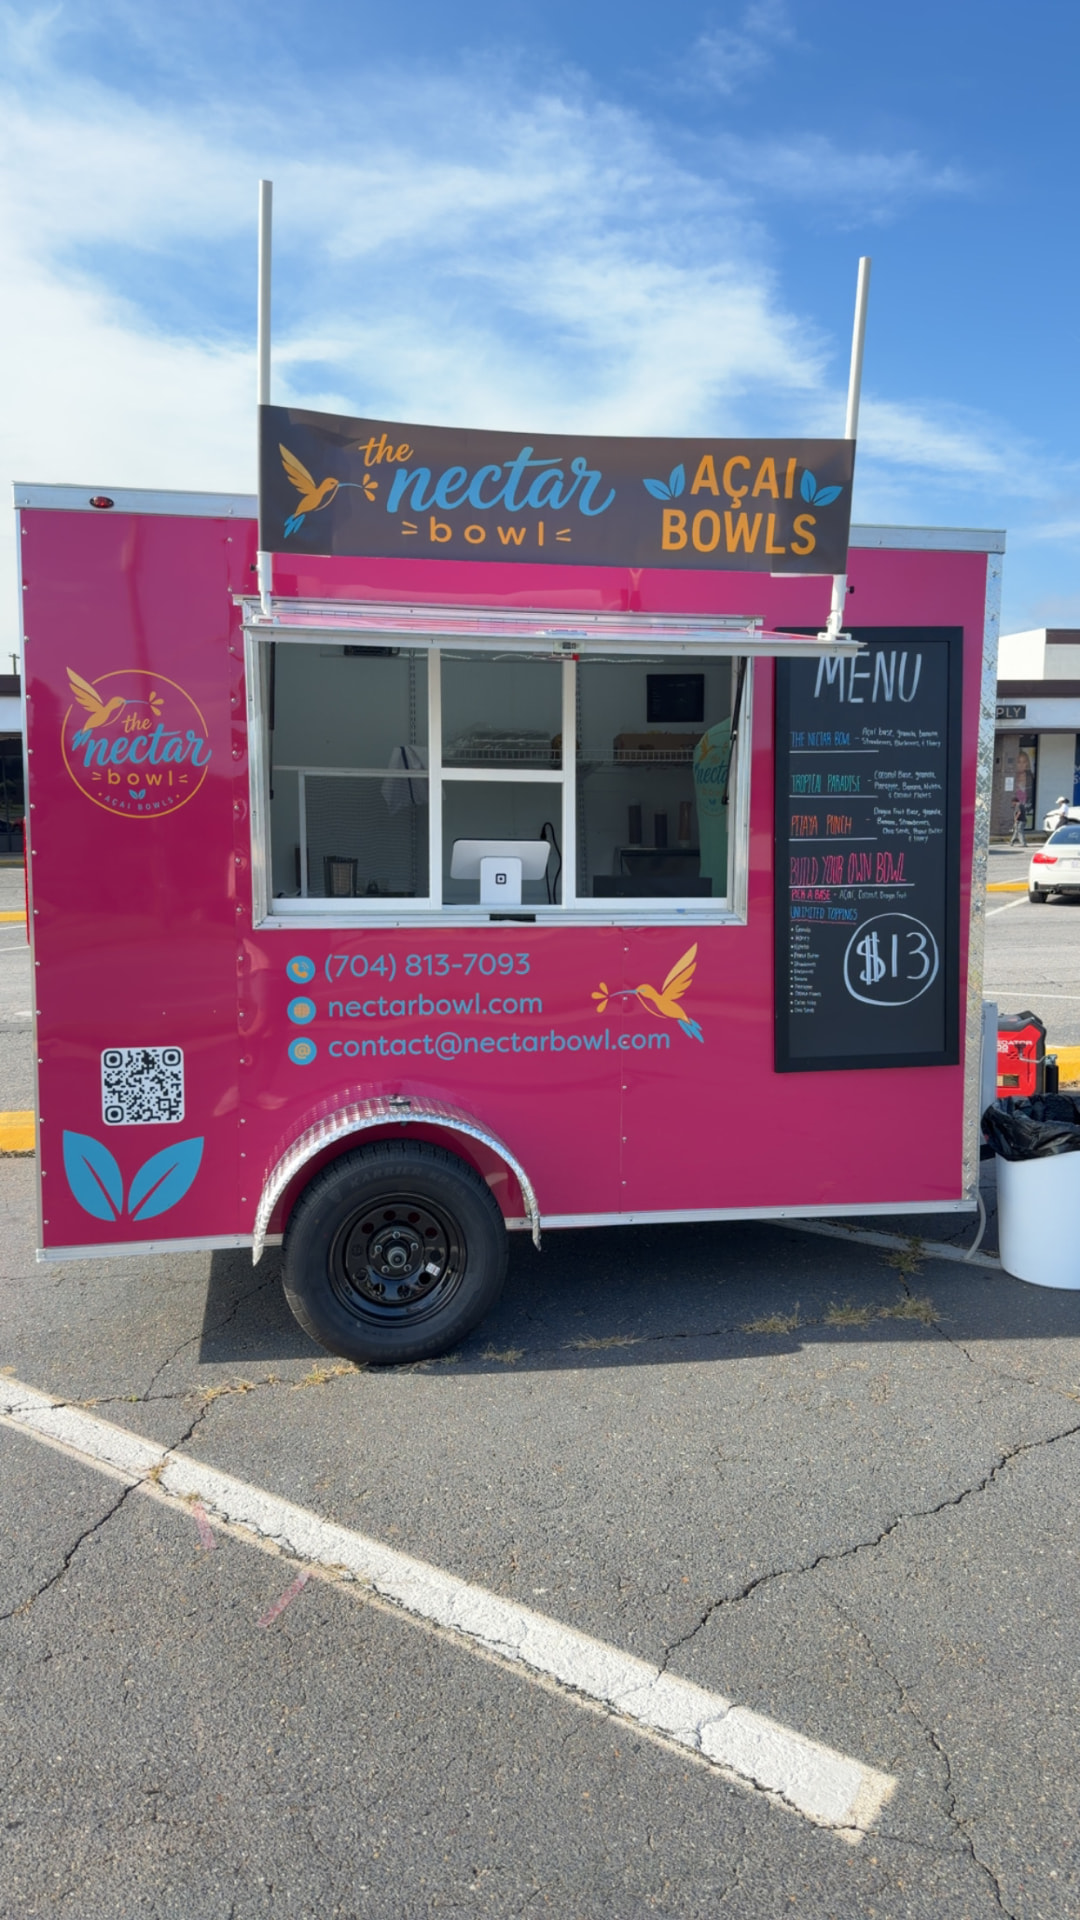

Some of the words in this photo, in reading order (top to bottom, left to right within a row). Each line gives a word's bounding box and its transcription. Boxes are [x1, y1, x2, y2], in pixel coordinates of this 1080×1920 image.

[357, 433, 414, 467] the
[386, 446, 616, 516] nectar
[689, 454, 798, 510] AÇAI
[429, 515, 545, 546] bowl
[661, 508, 818, 556] BOWLS
[813, 650, 923, 703] MENU
[121, 711, 152, 734] the
[84, 723, 212, 767] nectar
[790, 731, 805, 747] THE
[107, 767, 173, 786] bowl
[791, 773, 822, 793] TROPICAL
[827, 774, 861, 793] PARADISE
[137, 796, 174, 811] BOWLS
[790, 814, 819, 837] PITAYA
[825, 813, 853, 837] PUNCH
[789, 856, 819, 886] BUILD
[821, 855, 844, 885] YOUR
[847, 852, 873, 885] OWN
[875, 851, 907, 884] BOWL
[807, 888, 813, 899] A
[814, 888, 830, 900] BASE
[789, 905, 825, 920] UNLIMITED
[826, 906, 859, 921] TOPPINGS
[324, 953, 397, 983] (704)
[404, 952, 531, 977] 813-7093
[855, 930, 931, 986] $13
[328, 993, 543, 1018] nectarbowl.com
[328, 1028, 671, 1061] contact@nectarbowl.com
